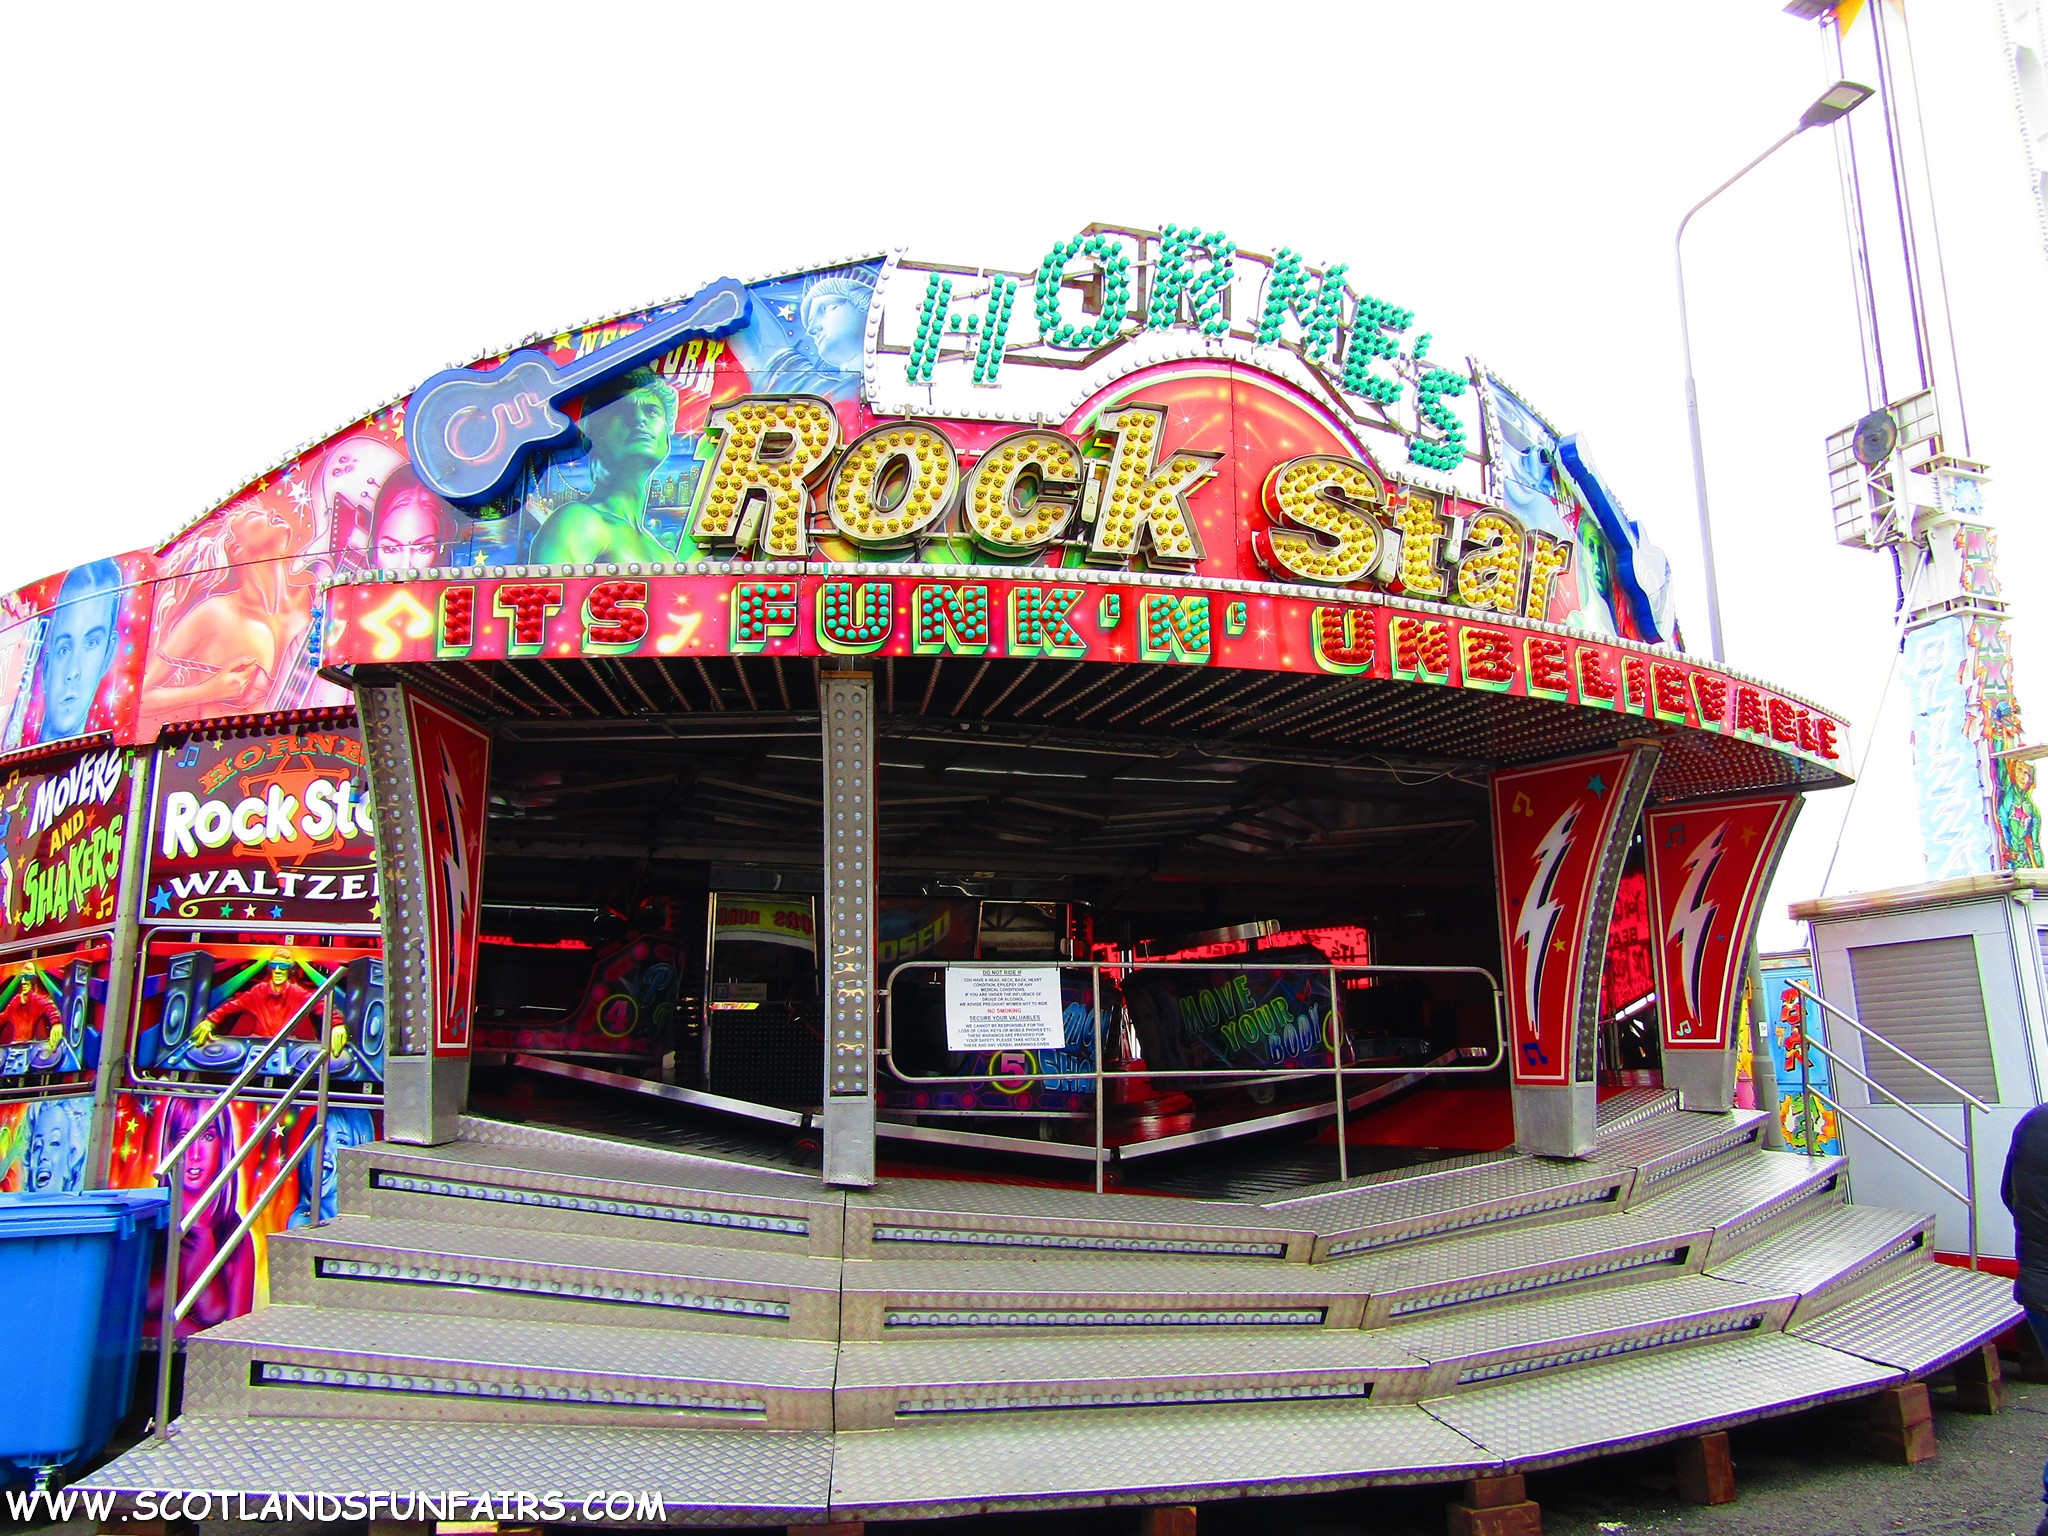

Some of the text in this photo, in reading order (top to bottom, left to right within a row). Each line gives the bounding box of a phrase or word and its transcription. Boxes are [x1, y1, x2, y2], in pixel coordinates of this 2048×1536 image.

[905, 222, 1472, 472] HORNE'S
[692, 394, 1575, 622] Rock Star
[437, 582, 649, 658] ITS
[1311, 605, 1840, 762] UNBELIEVABLE
[27, 747, 123, 839] MOVERS
[162, 783, 298, 861] Rock
[49, 809, 86, 858] AND
[22, 814, 124, 931] SHAKERS
[169, 871, 379, 901] WALTZE
[604, 1000, 630, 1031] 4
[1178, 975, 1257, 1036] MOVE
[1220, 996, 1295, 1052] YOUR
[1268, 1001, 1323, 1065] BODY
[1001, 1053, 1026, 1087] 5
